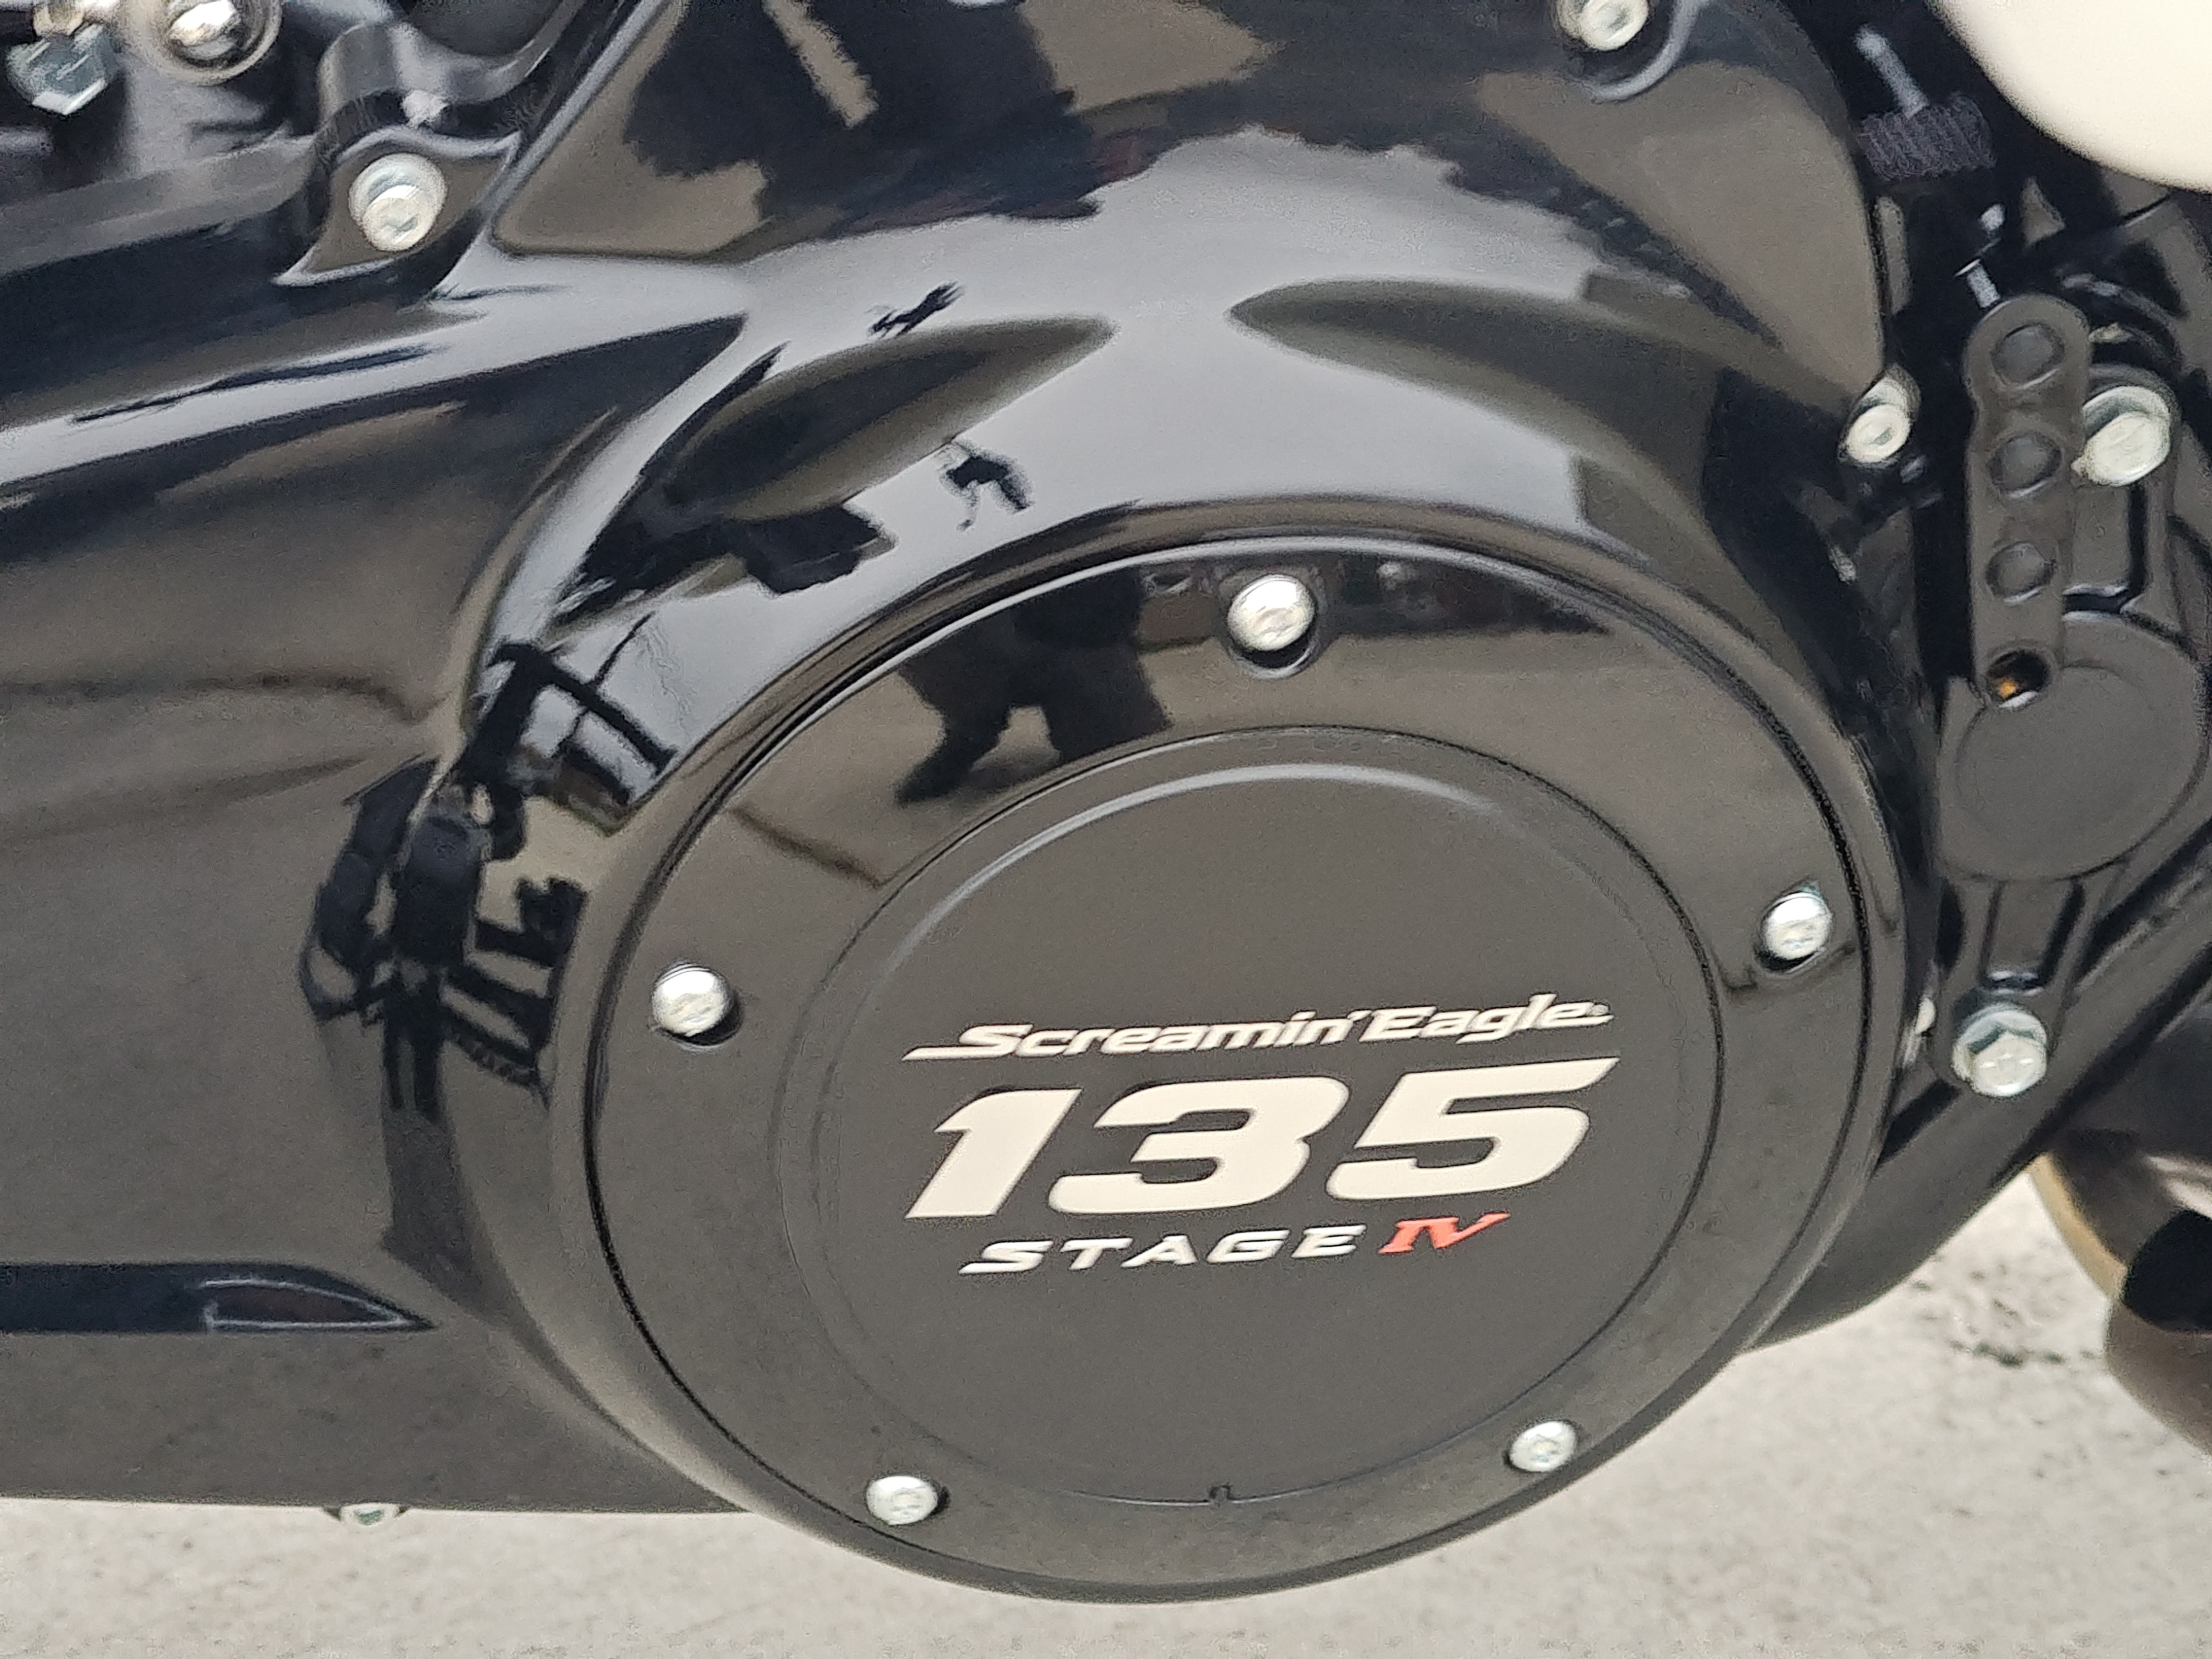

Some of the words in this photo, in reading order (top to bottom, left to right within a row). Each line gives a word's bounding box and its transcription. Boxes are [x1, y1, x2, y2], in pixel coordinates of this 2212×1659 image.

[904, 1057, 1621, 1219] 135
[958, 1223, 1367, 1274] STAGE
[1378, 1212, 1511, 1255] IV
